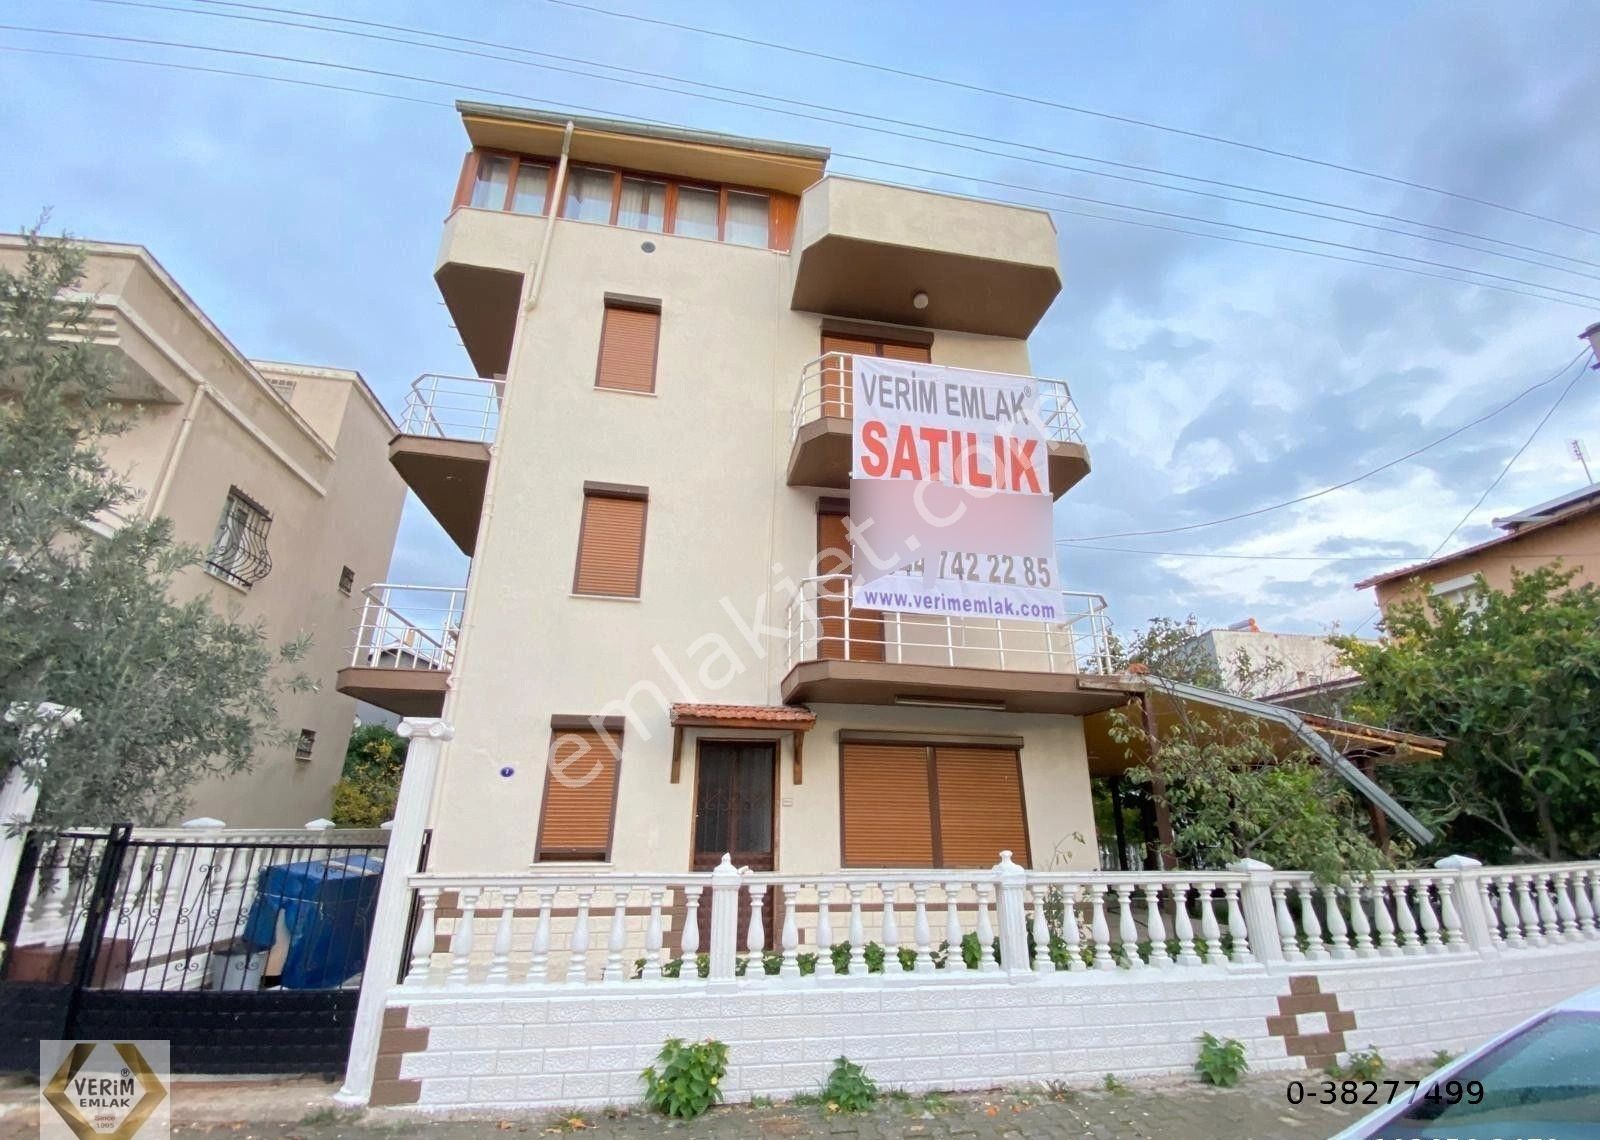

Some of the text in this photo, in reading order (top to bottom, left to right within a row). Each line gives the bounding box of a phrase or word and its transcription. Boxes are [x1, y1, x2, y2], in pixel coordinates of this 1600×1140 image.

[861, 370, 939, 415] VERİM
[860, 420, 1043, 494] SATILIK
[939, 550, 980, 582] 742
[987, 553, 1017, 585] 22
[1023, 556, 1051, 588] 85
[864, 590, 1056, 619] www.verimemlak.com
